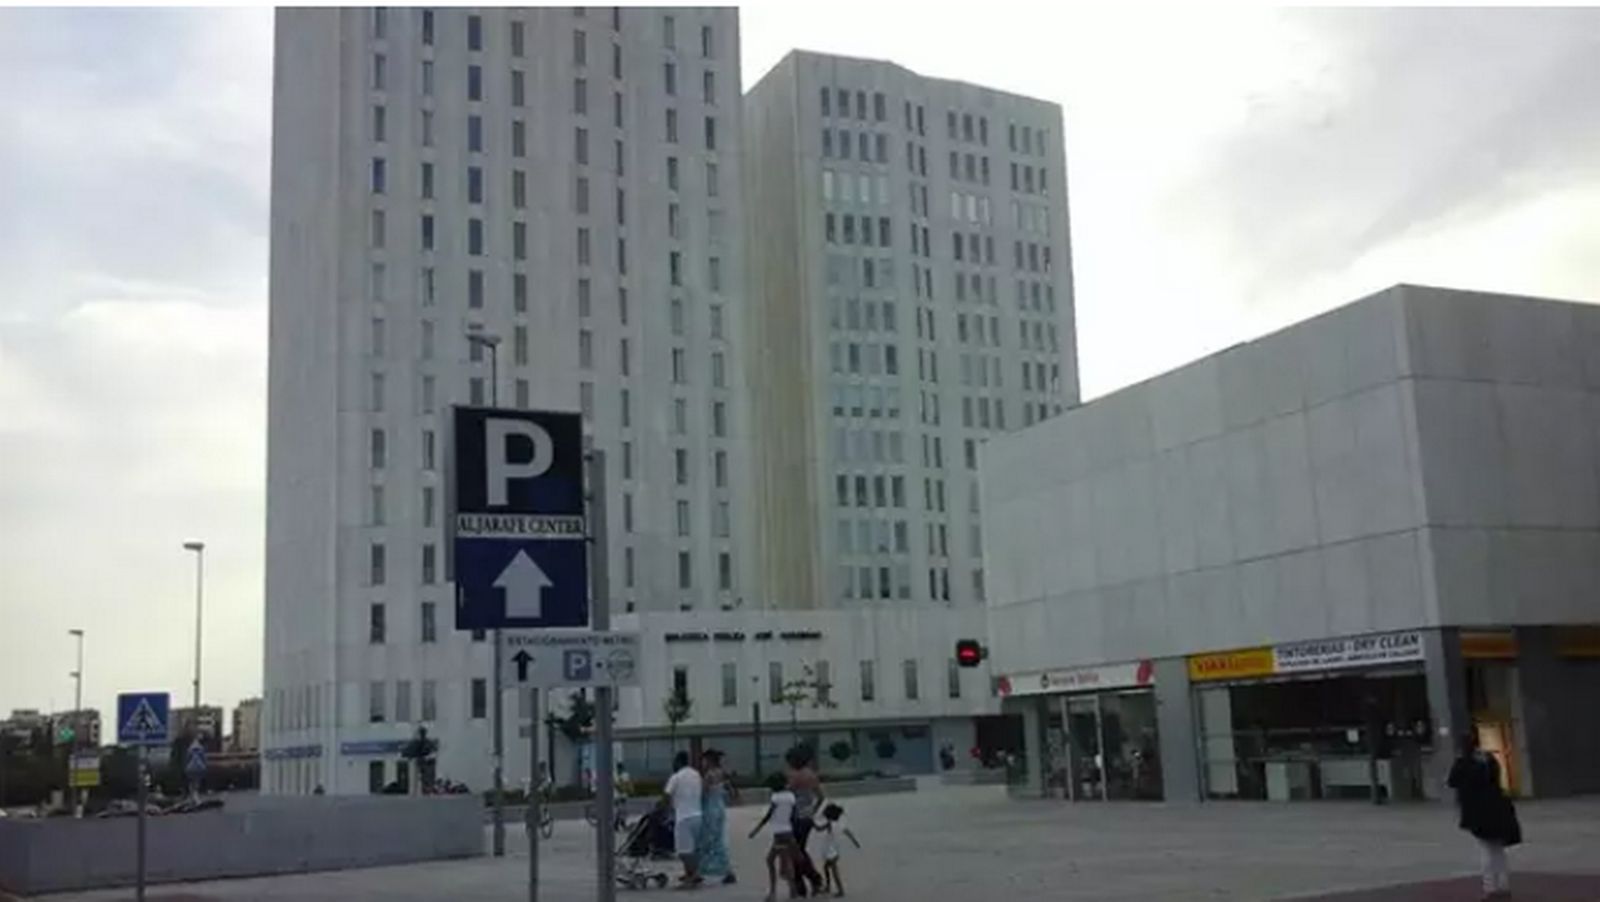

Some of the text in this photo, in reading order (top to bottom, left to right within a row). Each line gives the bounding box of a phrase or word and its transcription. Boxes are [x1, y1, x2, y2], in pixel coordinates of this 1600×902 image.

[485, 418, 554, 506] P
[458, 516, 583, 535] ALJARAFE CENTER
[1379, 634, 1419, 649] CLEAN
